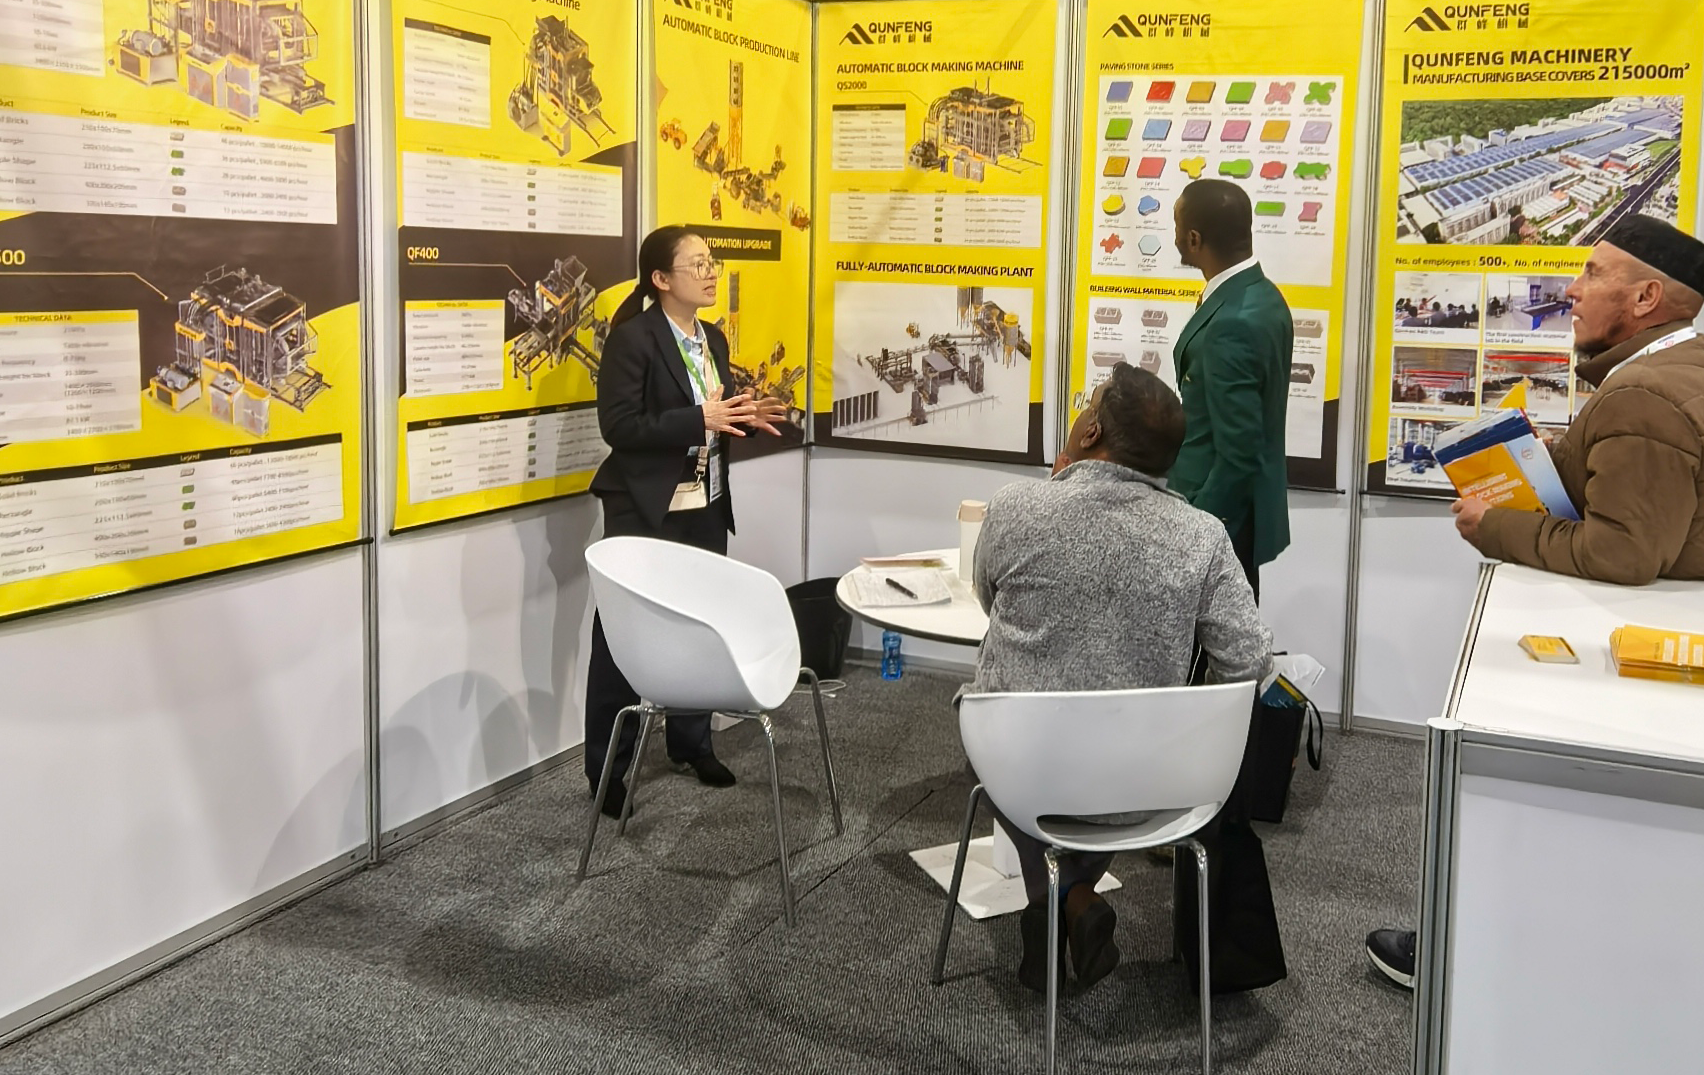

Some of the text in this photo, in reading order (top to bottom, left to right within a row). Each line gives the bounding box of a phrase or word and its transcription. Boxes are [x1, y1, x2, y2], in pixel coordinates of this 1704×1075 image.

[547, 0, 580, 10] chine
[1445, 3, 1530, 18] QUNFENG
[1138, 13, 1211, 26] QUNFENG
[868, 21, 932, 33] QUNFENG
[663, 14, 799, 63] AUTOMATIC BLOCK PRODUCTION LINE
[1411, 47, 1632, 69] QUNFENG MACHINERY
[837, 60, 1024, 73] AUTOMATIC BLOCK MAKING MACHINE
[1100, 63, 1126, 71] PAVING
[1412, 71, 1514, 84] MANUFACTURING
[1516, 70, 1547, 83] BASE
[1548, 70, 1595, 82] COVERS
[703, 237, 772, 250] UTOMATION UPGRADE
[0, 250, 26, 265] 00
[407, 247, 440, 260] QF400
[836, 261, 1034, 278] FULLY-AUTOMATIC BLOCK MAKING PLANT
[1412, 257, 1422, 265] of
[1422, 258, 1471, 268] employees
[1532, 259, 1542, 267] of
[1543, 260, 1585, 269] engineer
